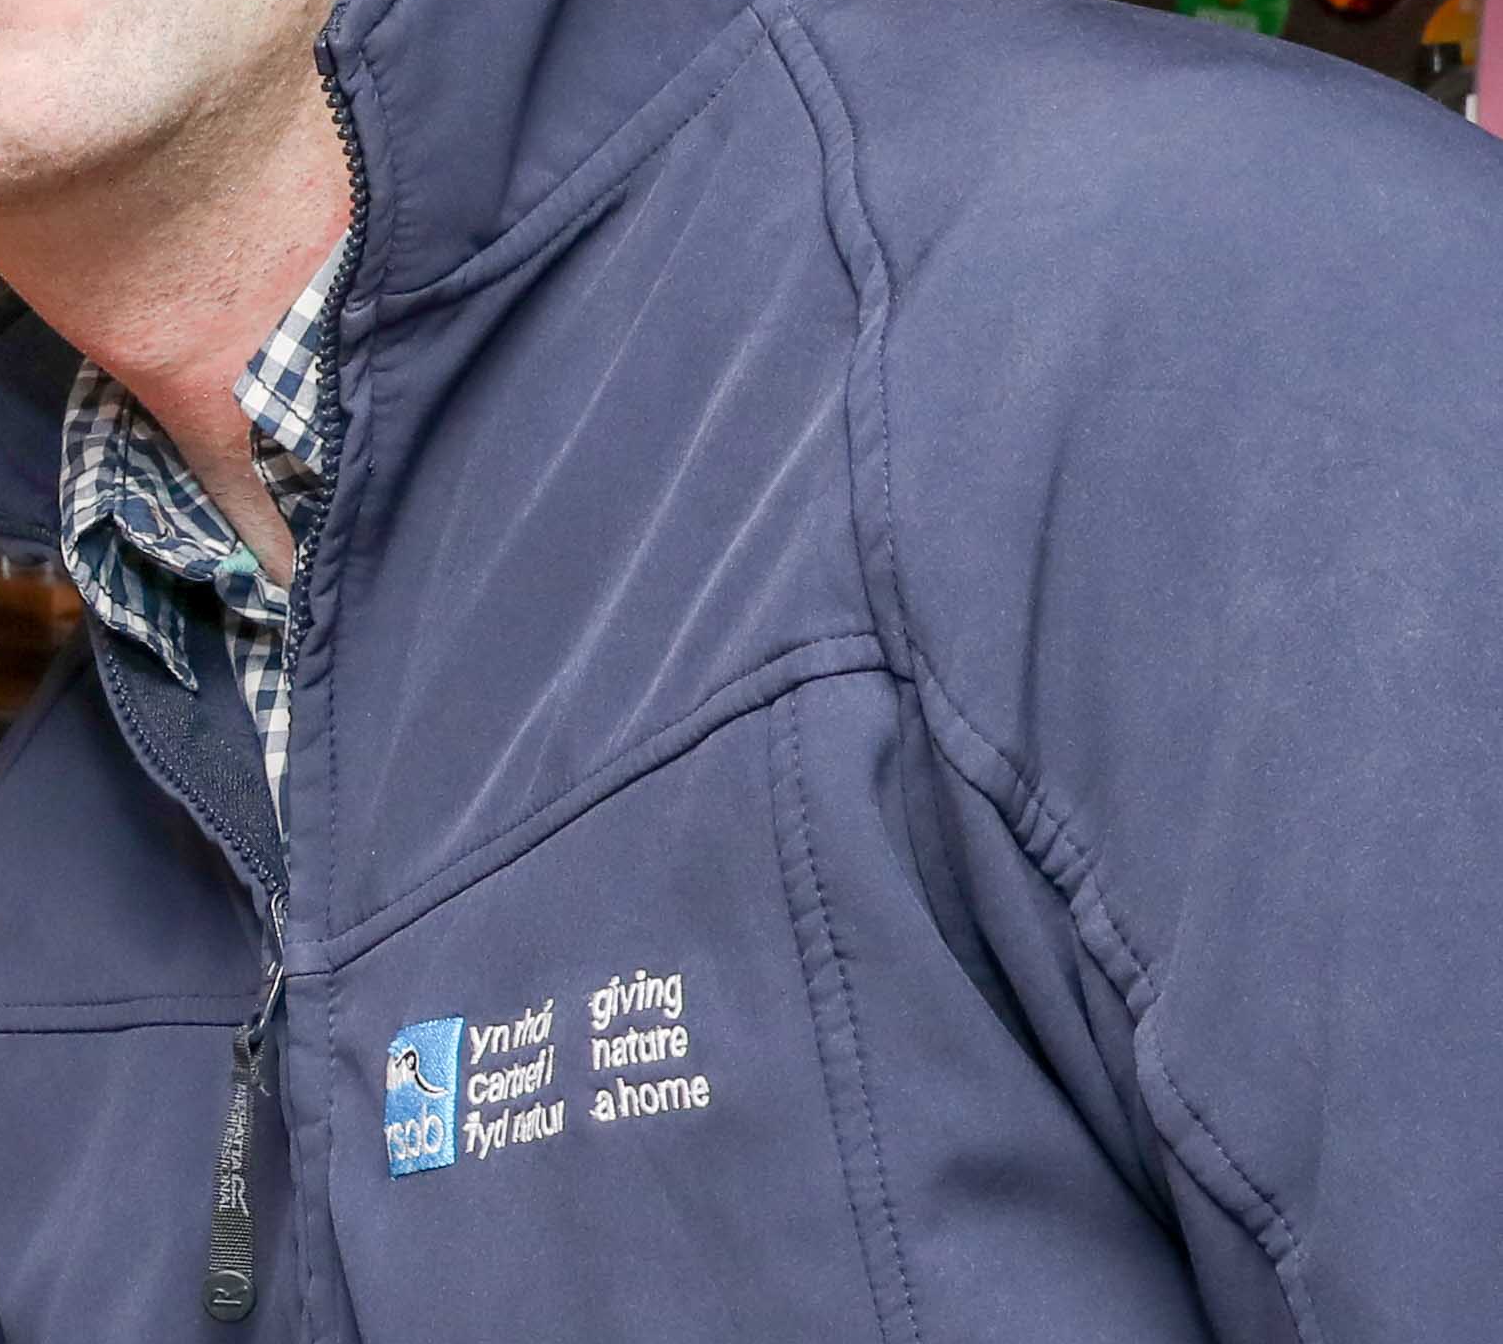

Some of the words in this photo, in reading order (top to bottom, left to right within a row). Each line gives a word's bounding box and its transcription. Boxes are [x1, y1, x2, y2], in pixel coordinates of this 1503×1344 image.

[589, 968, 684, 1031] giving
[469, 1024, 508, 1065] yn
[513, 998, 555, 1048] rhoi
[591, 1024, 689, 1071] nature
[511, 1098, 567, 1145] natur
[590, 1087, 617, 1123] a
[616, 1073, 712, 1118] home
